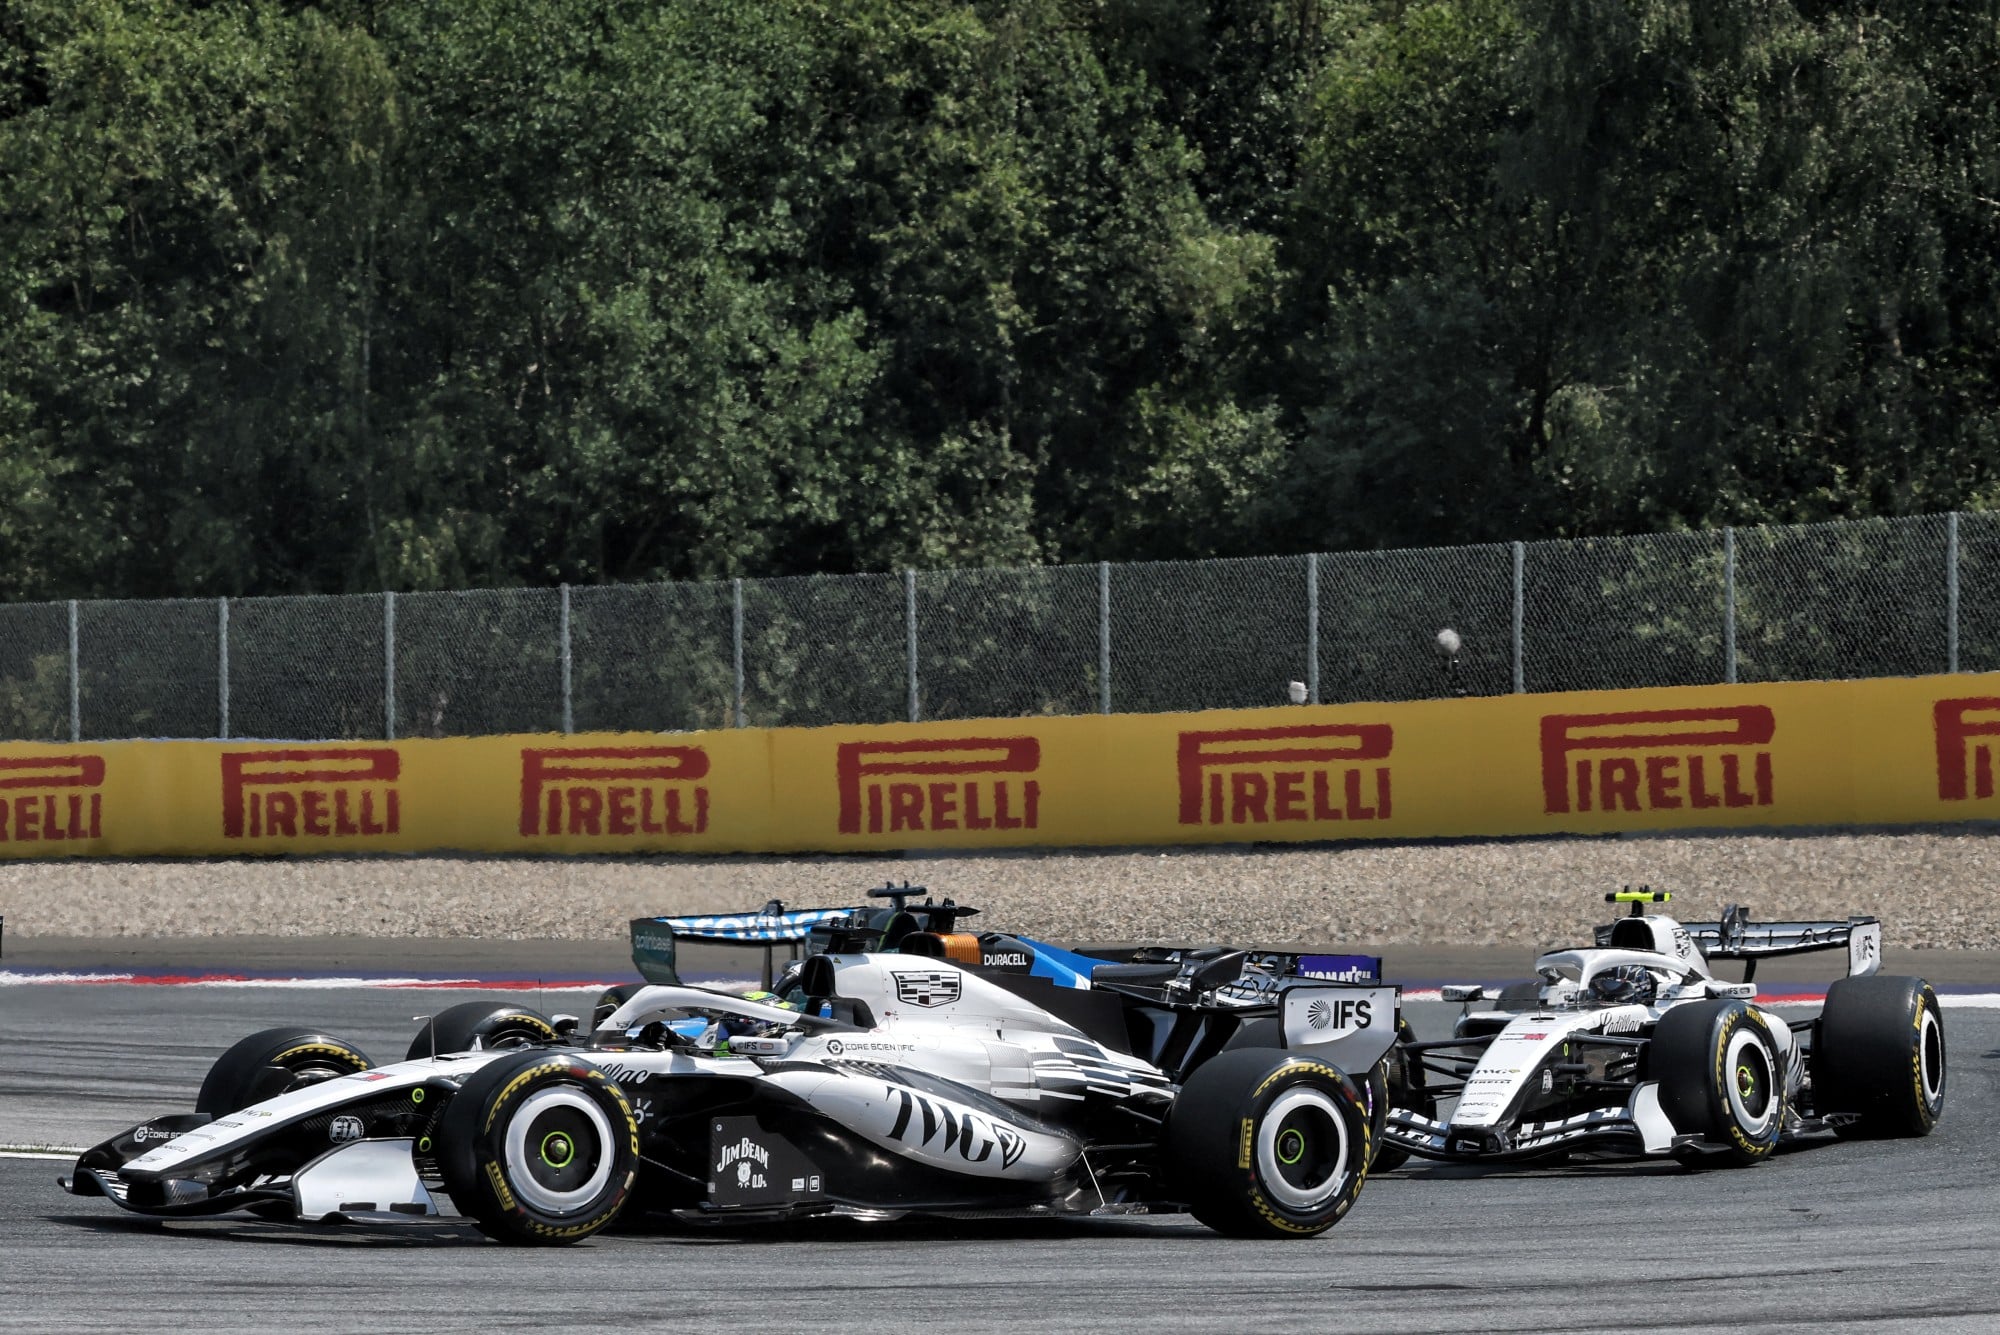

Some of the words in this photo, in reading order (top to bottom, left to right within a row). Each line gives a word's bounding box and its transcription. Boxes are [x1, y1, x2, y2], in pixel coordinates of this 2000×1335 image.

[836, 736, 1040, 834] PIRELLI
[1177, 723, 1394, 825] PIRELLI
[1540, 704, 1776, 813] PIRELLI
[221, 748, 401, 837] PIRELLI
[520, 746, 710, 836] PIRELLI
[984, 953, 1027, 966] DURACELL
[1333, 999, 1372, 1029] IFS
[744, 1041, 758, 1050] IFS
[845, 1043, 869, 1051] CORE
[149, 1131, 170, 1139] CORE
[885, 1085, 995, 1163] TWG
[716, 1143, 740, 1173] JIM
[741, 1137, 769, 1170] BEAM
